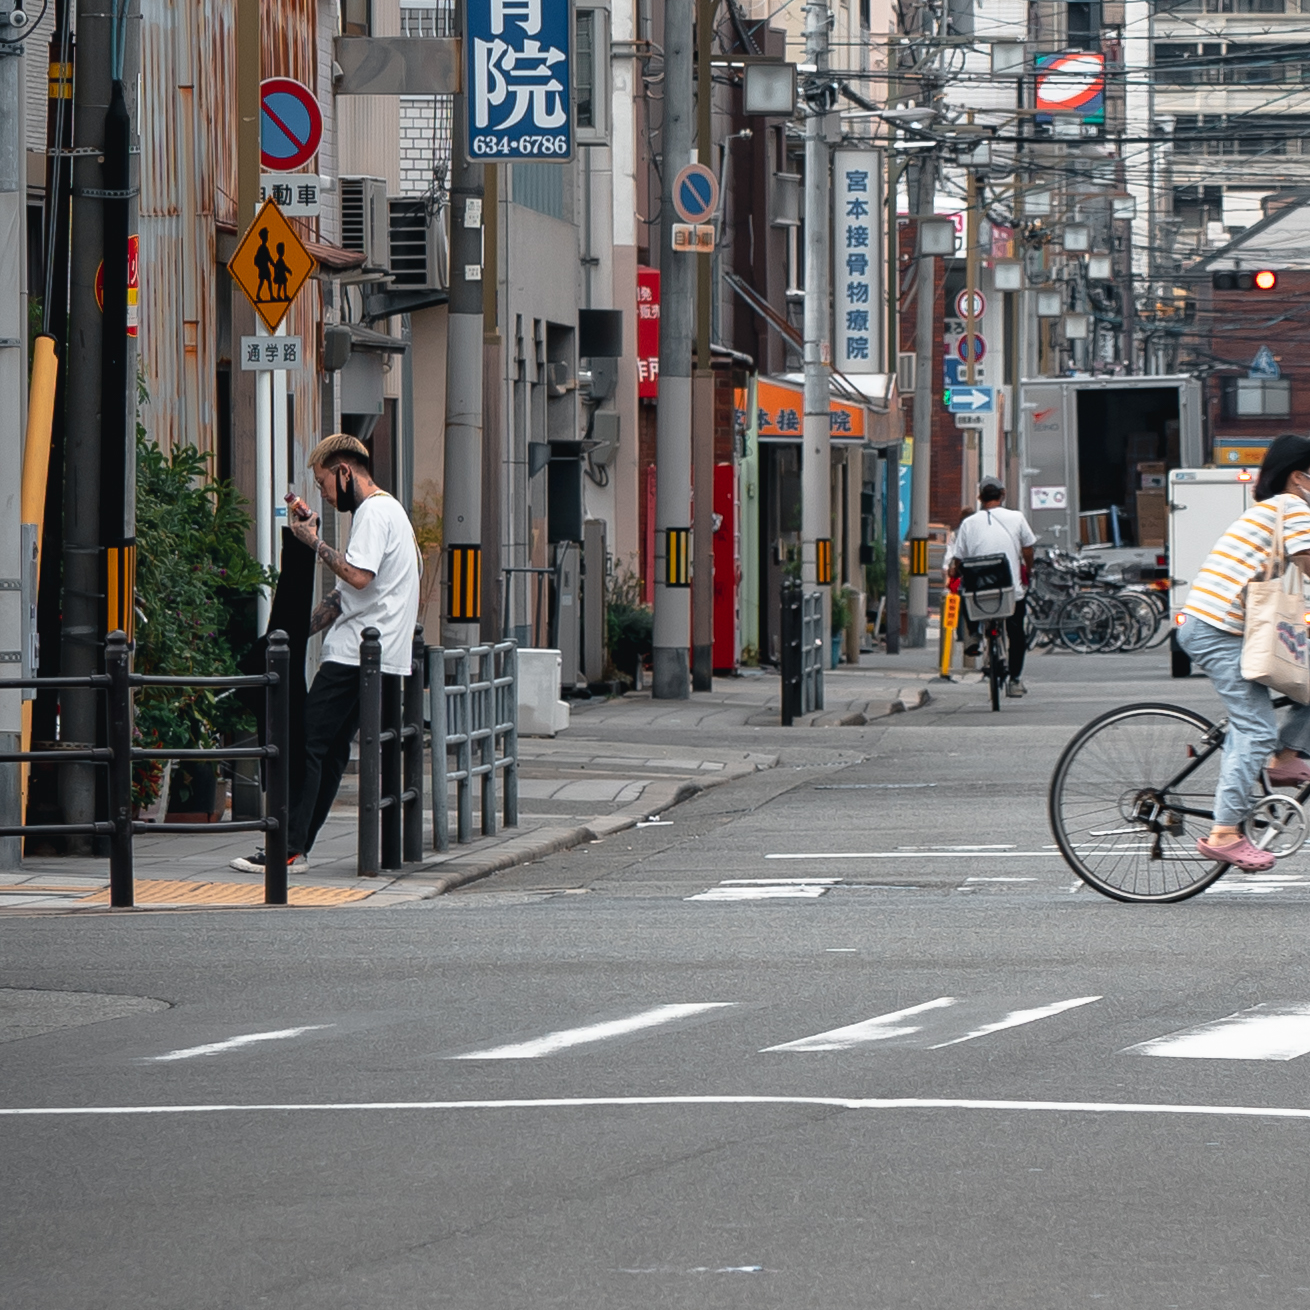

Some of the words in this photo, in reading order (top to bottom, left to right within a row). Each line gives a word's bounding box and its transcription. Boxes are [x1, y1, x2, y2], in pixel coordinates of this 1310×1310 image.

[260, 184, 318, 206] 動車
[846, 170, 869, 360] 宮本接骨物療院
[247, 344, 297, 362] 通学路
